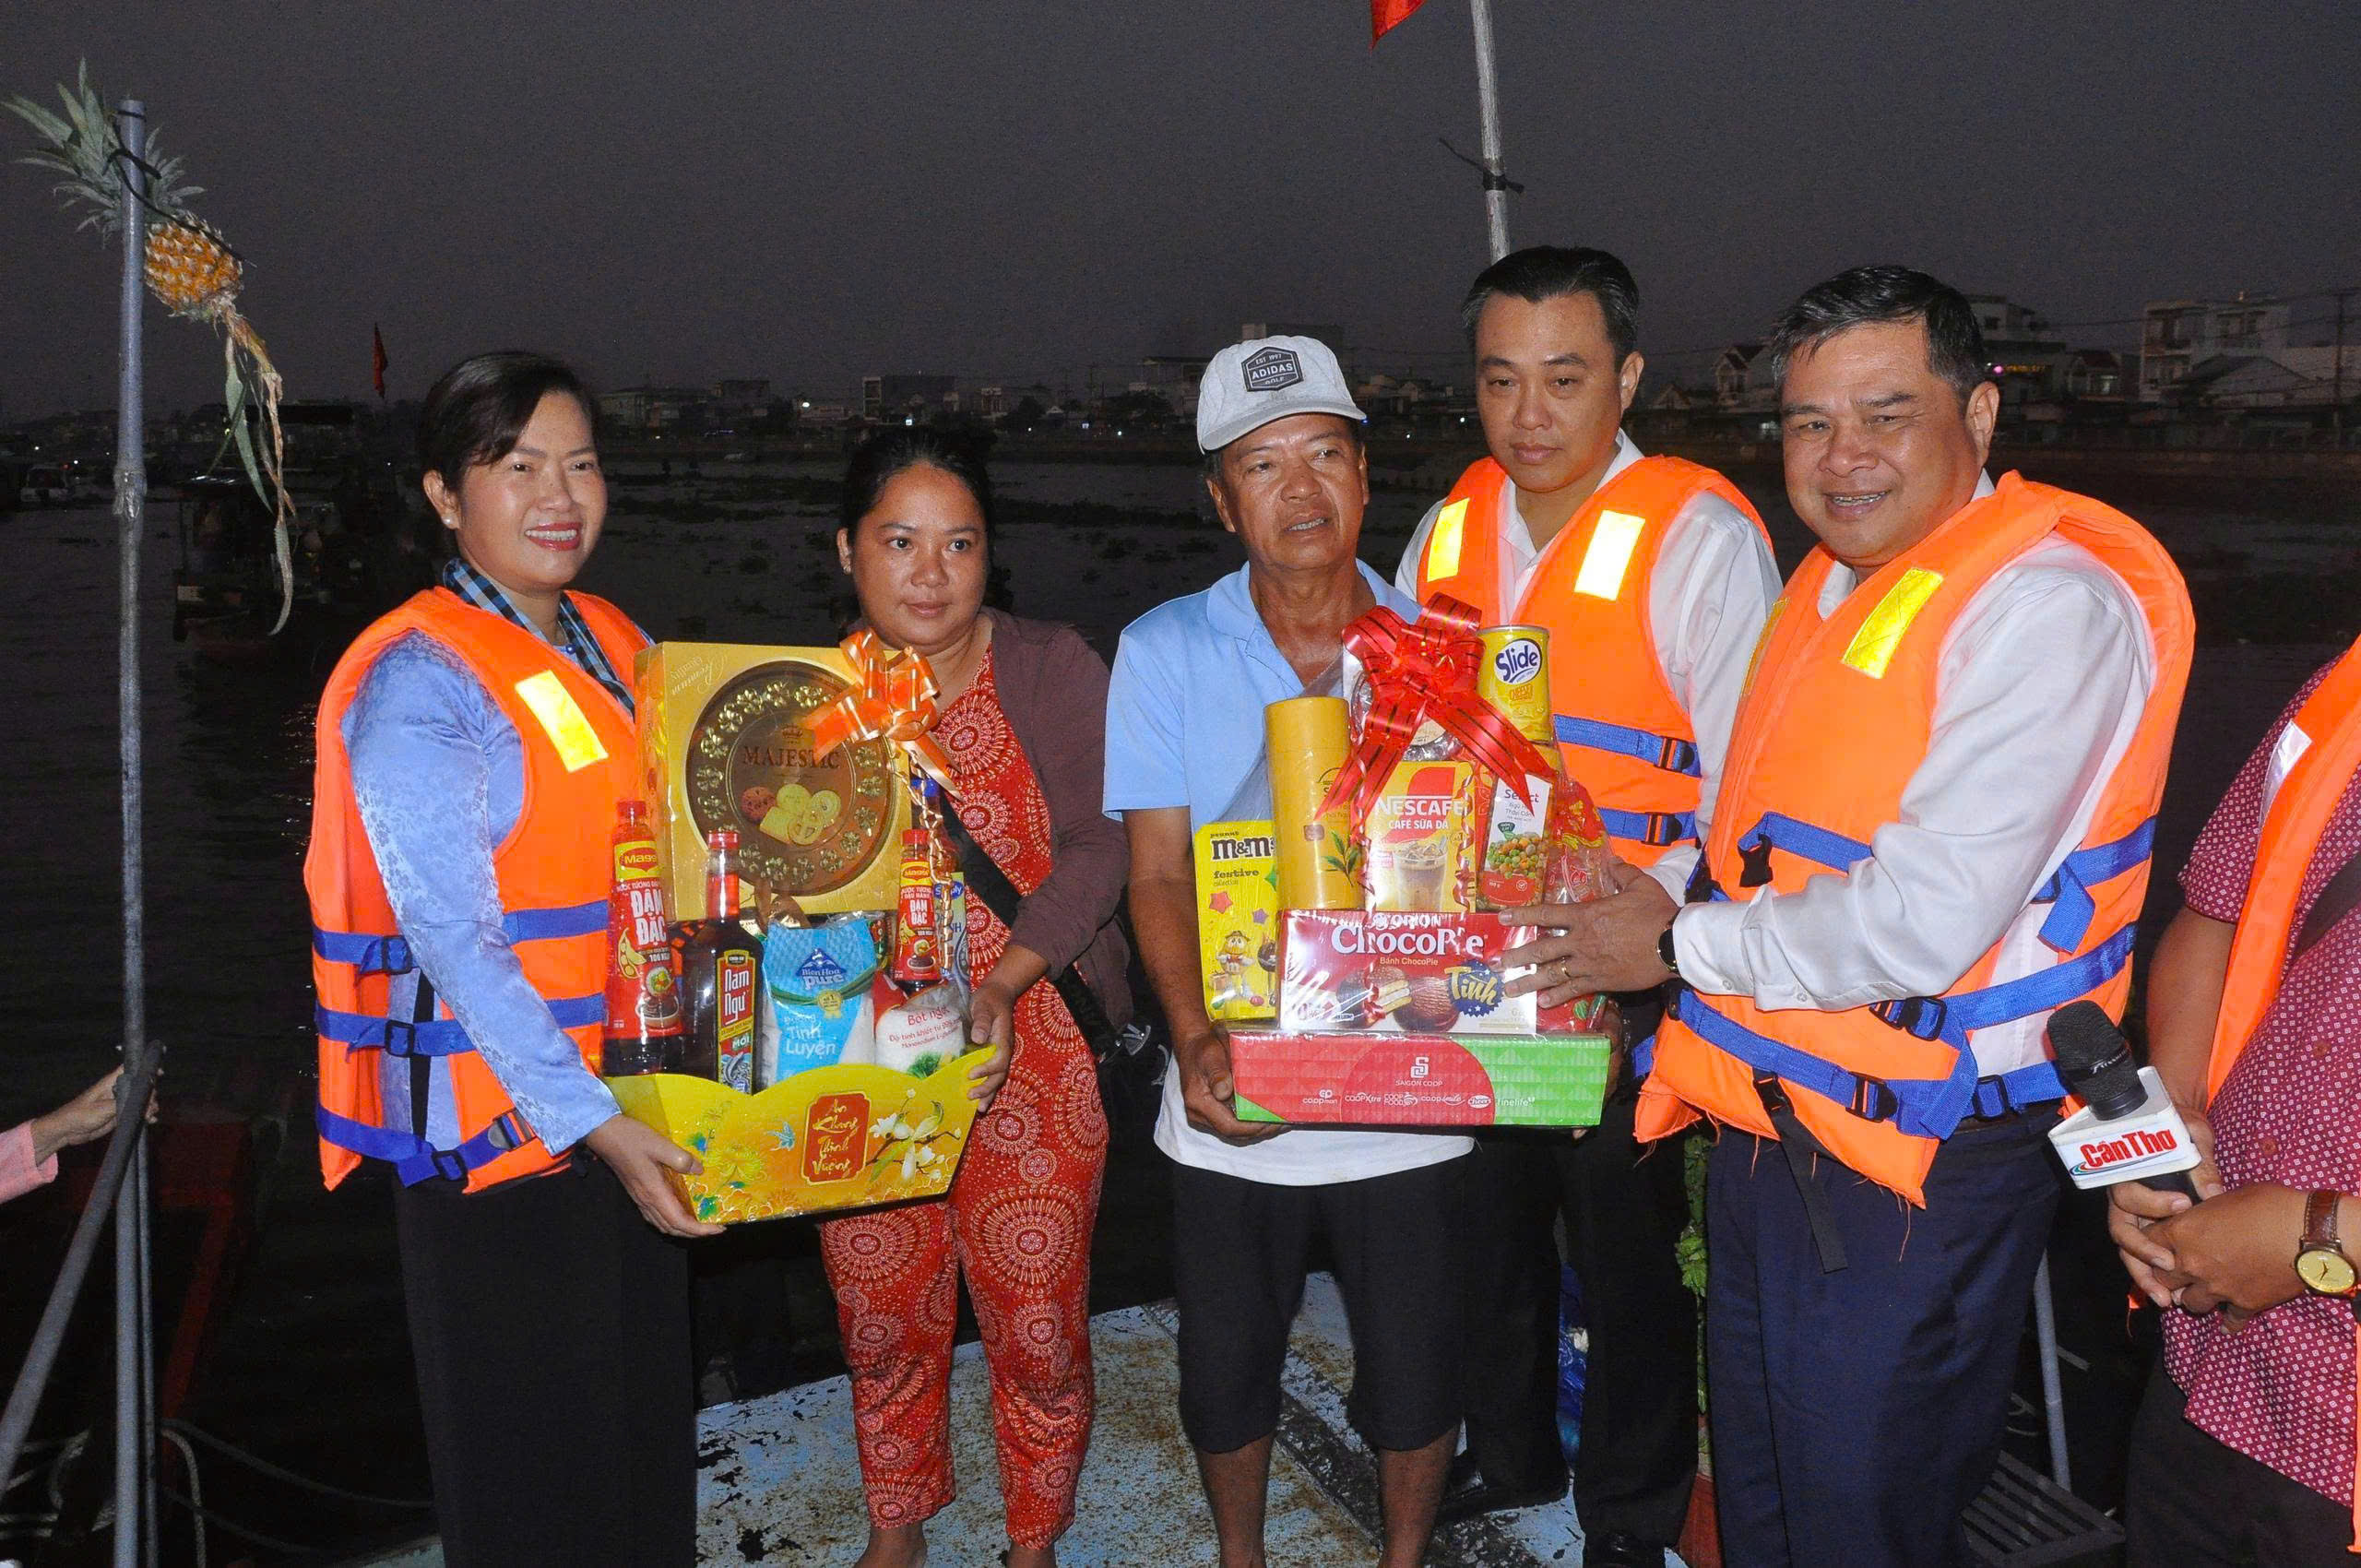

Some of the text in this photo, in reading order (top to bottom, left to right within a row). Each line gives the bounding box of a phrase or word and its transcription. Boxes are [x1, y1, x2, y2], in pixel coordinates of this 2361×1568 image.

[1252, 362, 1293, 379] ADIDAS
[1495, 645, 1538, 682] Slide
[743, 745, 840, 768] MAJESTIC
[1504, 790, 1539, 802] Sect
[1214, 868, 1259, 879] festive
[635, 915, 667, 946] ĐẶC
[1380, 956, 1439, 966] Bánh ChocoPie
[725, 968, 749, 992] Nam
[805, 974, 844, 991] pure
[786, 1039, 836, 1060] Luyện
